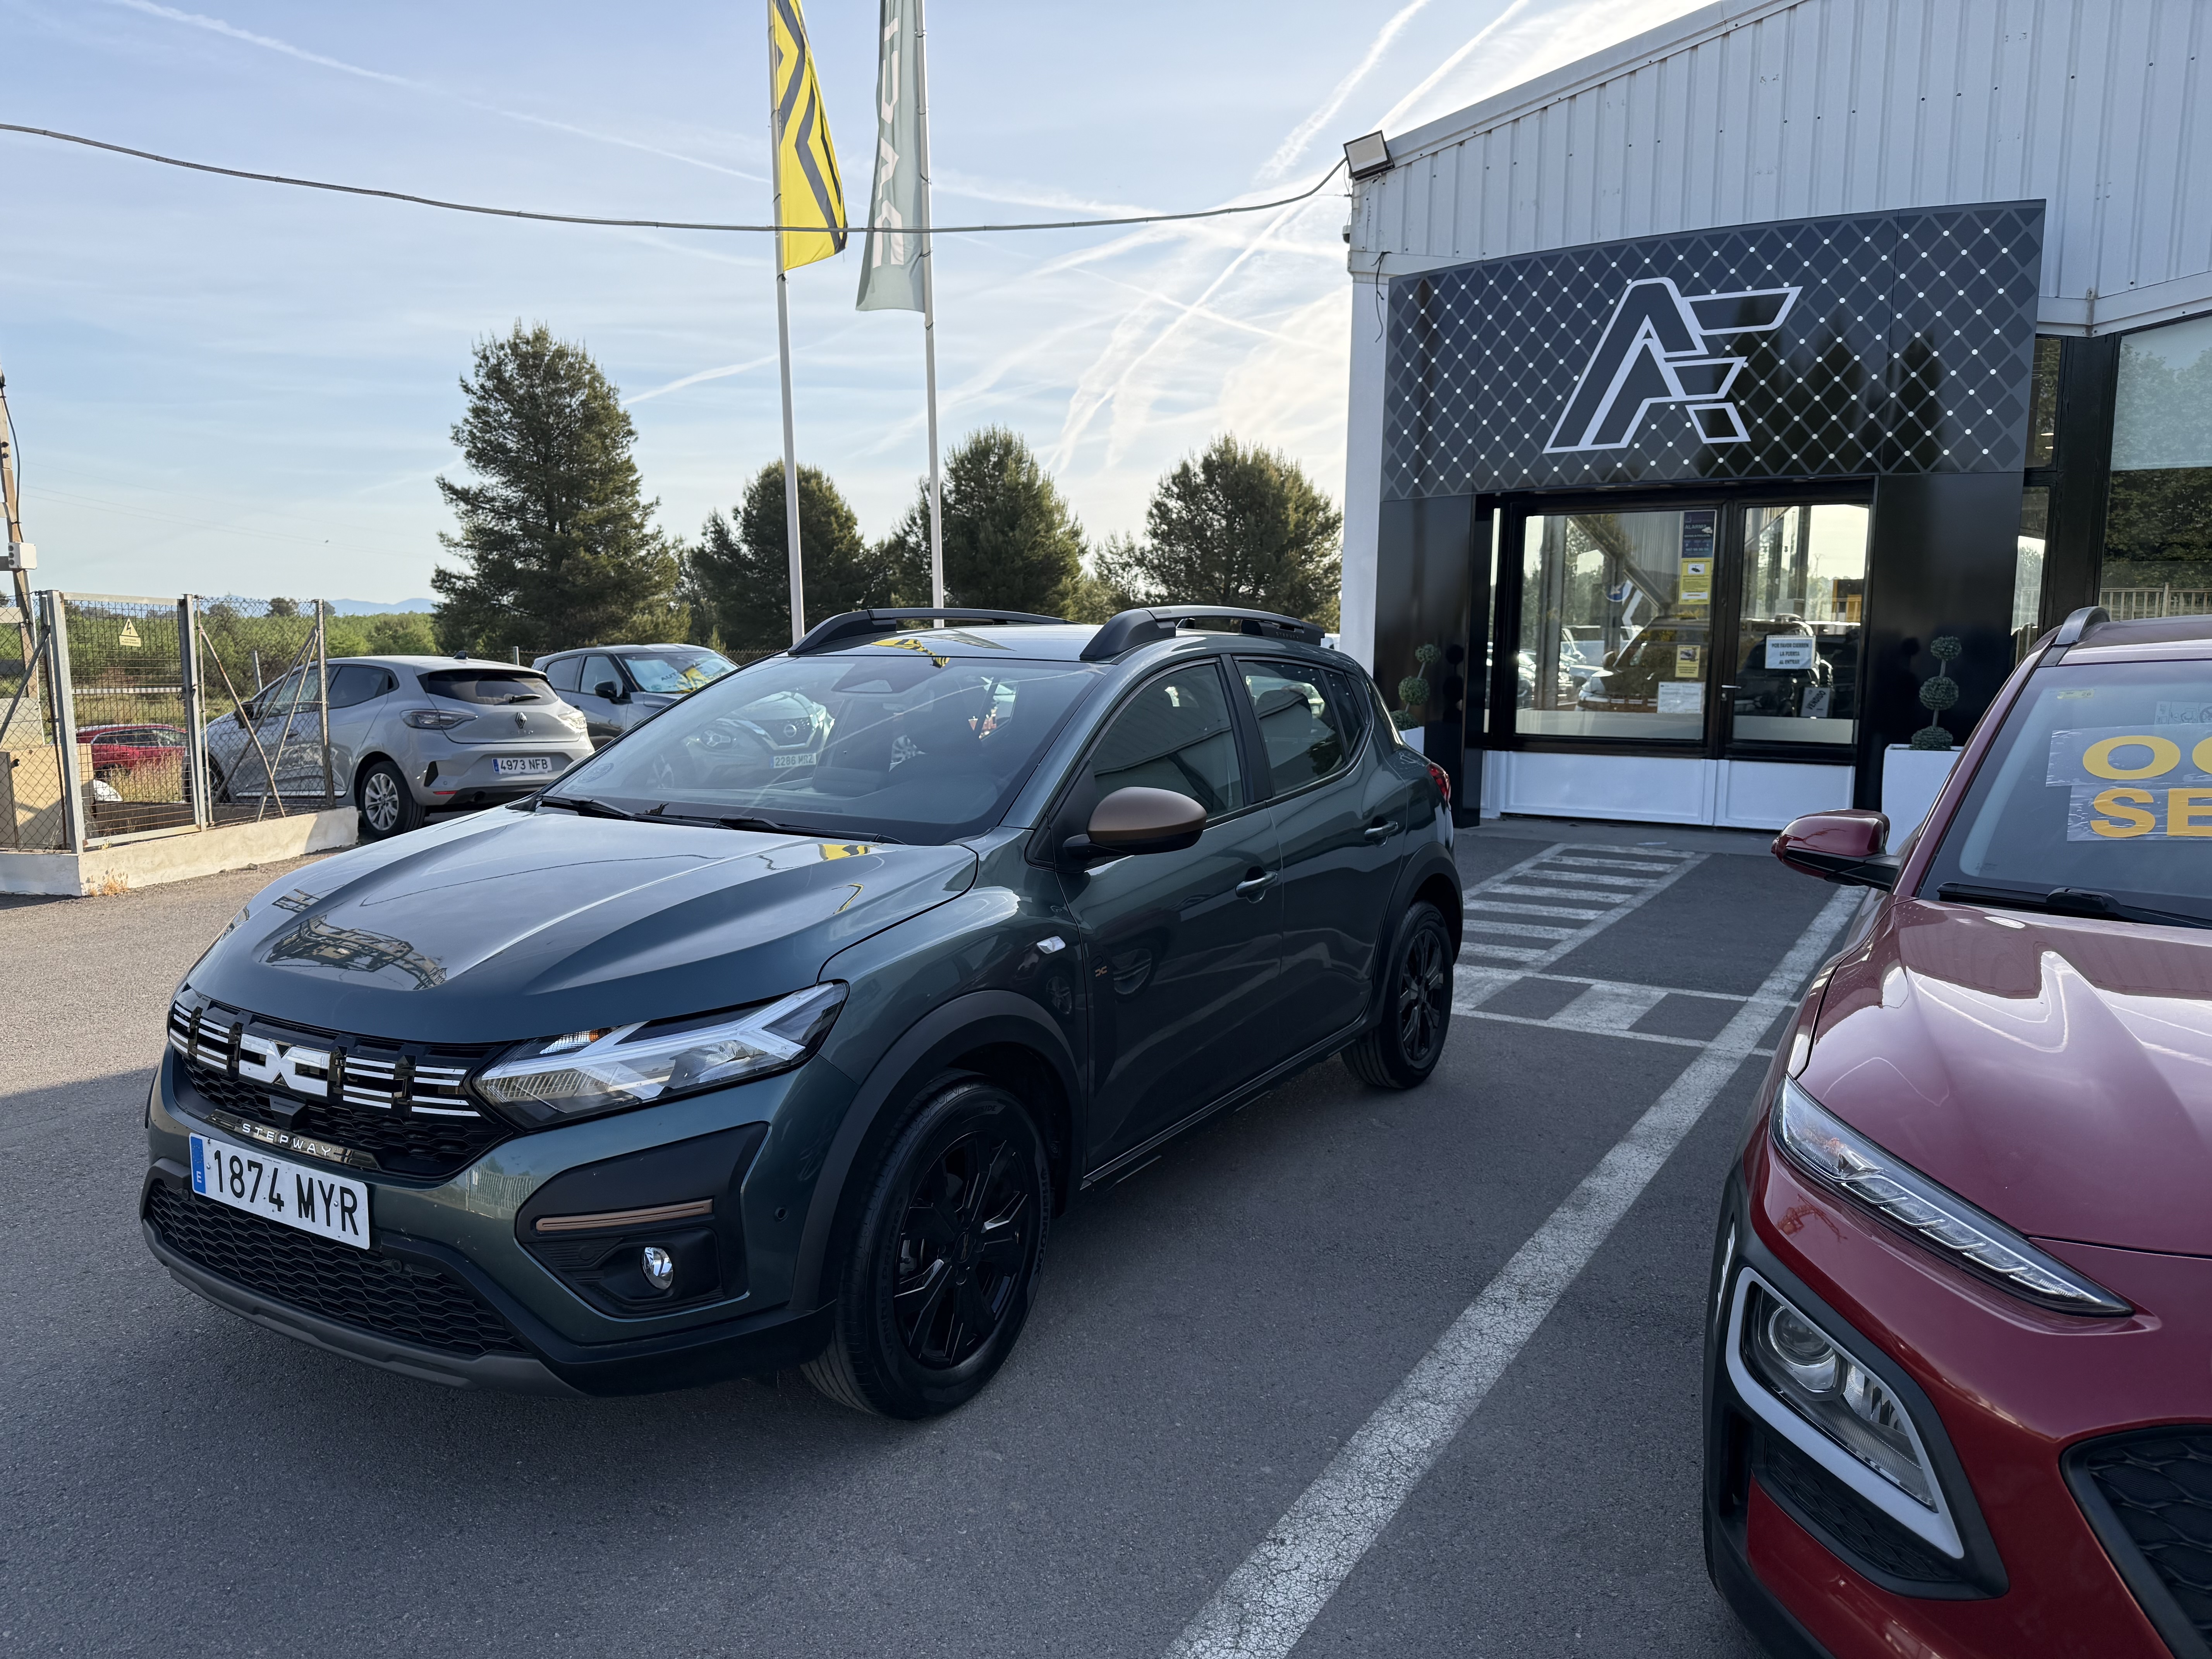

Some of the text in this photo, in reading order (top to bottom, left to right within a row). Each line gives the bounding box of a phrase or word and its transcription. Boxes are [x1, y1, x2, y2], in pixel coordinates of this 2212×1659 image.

[1805, 690, 1826, 709] VENDIDO
[500, 759, 526, 771] 4973
[529, 759, 548, 770] NFB
[775, 754, 814, 766] 2286 MRZ
[242, 1122, 332, 1156] STEPWAY
[196, 1170, 202, 1183] E
[214, 1150, 359, 1236] 1874 MYR
